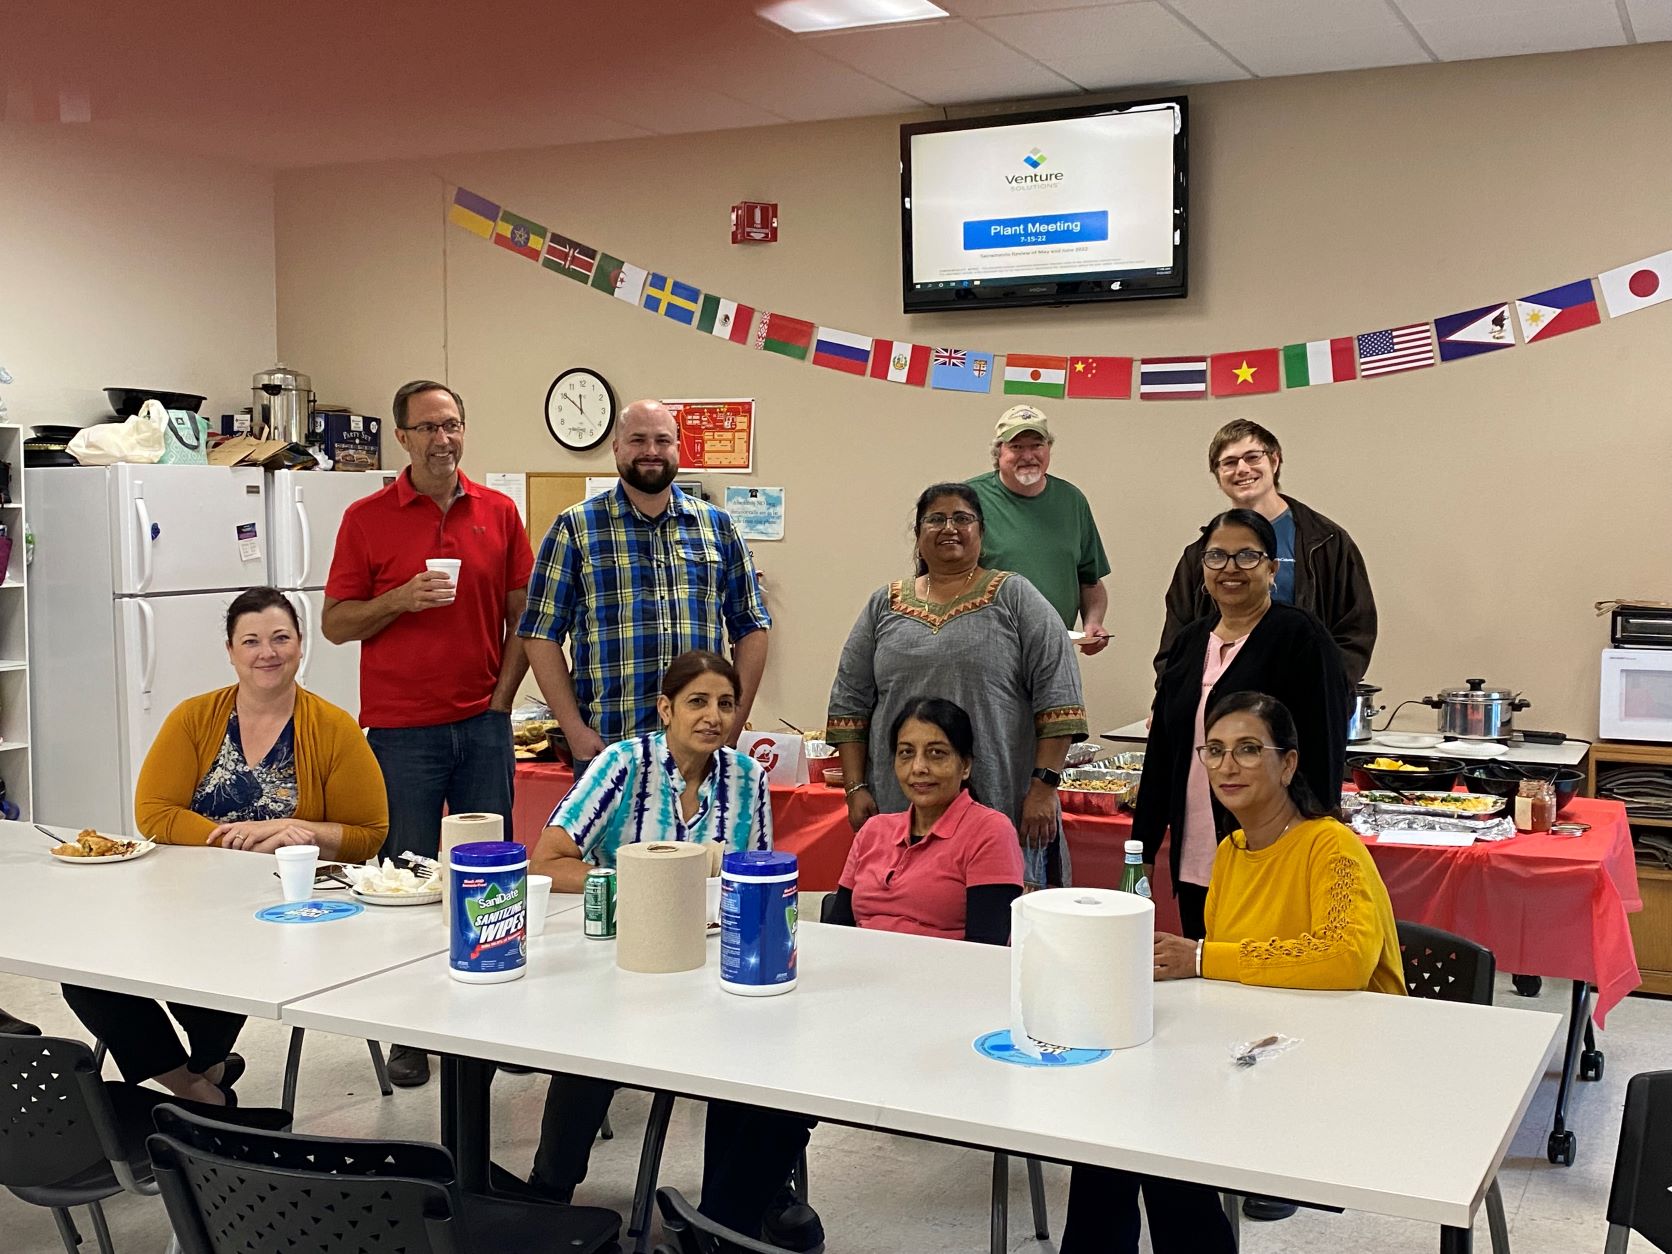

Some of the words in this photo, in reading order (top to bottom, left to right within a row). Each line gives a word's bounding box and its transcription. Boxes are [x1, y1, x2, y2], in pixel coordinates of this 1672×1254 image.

[1005, 172, 1064, 185] Venture
[1010, 183, 1059, 192] SOLUTIONS
[991, 224, 1025, 236] Plant
[1027, 220, 1081, 233] Meeting
[1020, 235, 1047, 243] 7-15-22
[569, 383, 575, 391] 11
[579, 380, 587, 388] 12
[478, 889, 519, 909] SaniDate
[480, 909, 525, 944] WIPES
